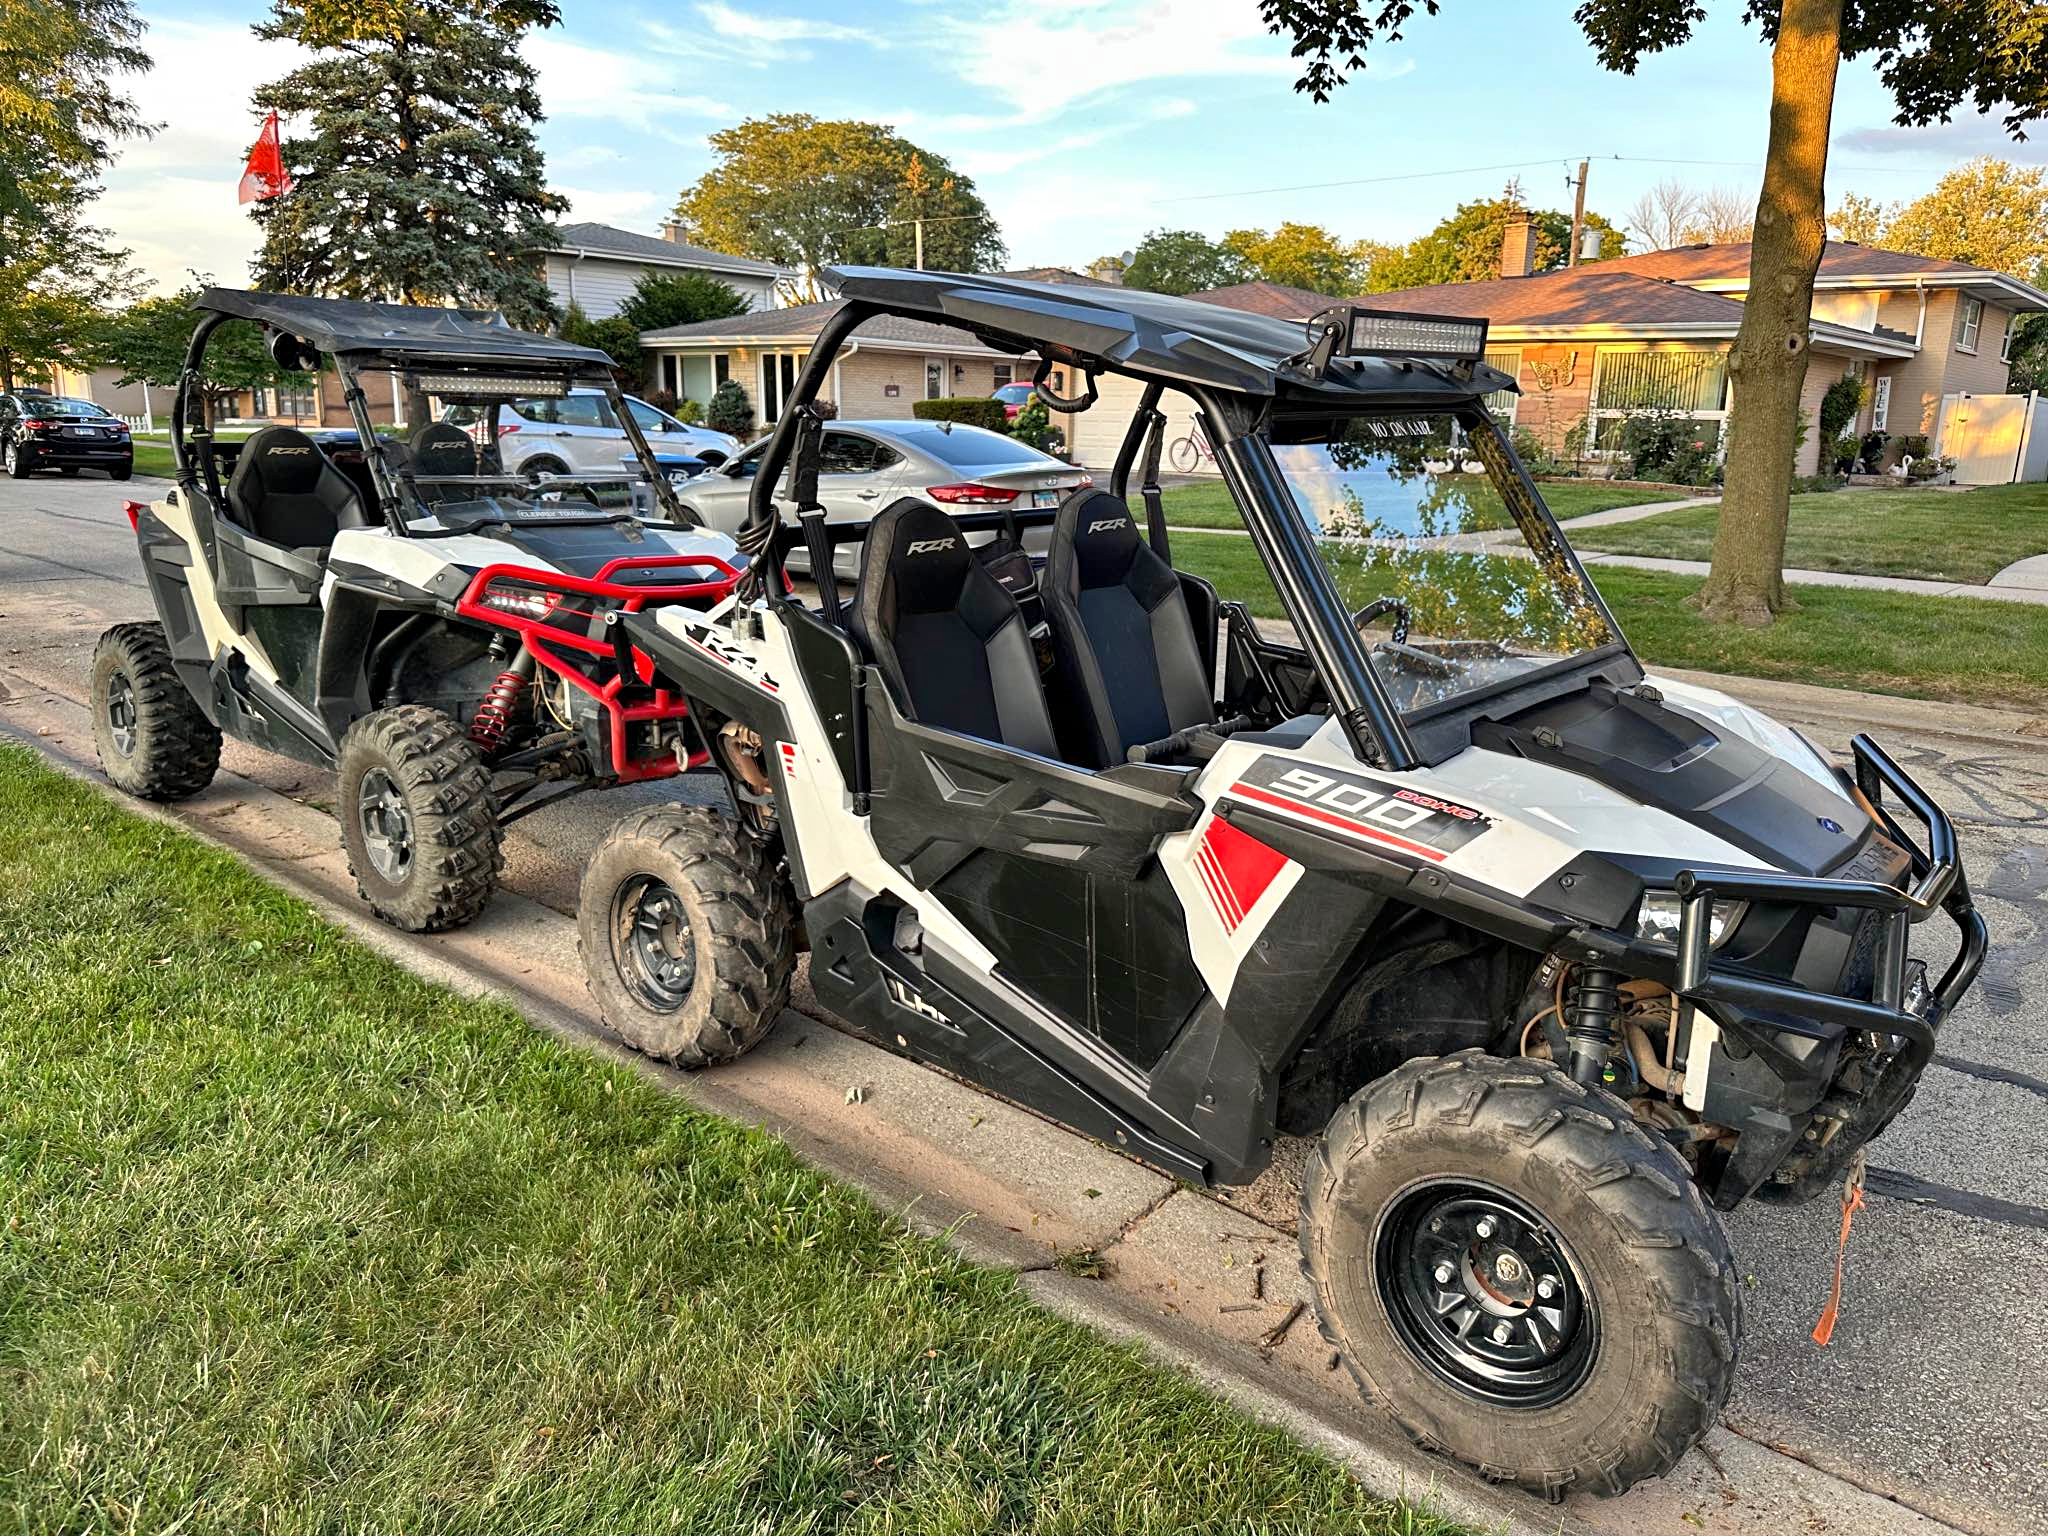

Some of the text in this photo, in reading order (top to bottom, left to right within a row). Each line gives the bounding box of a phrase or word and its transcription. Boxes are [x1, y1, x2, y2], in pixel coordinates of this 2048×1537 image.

[266, 447, 310, 456] RZR
[431, 441, 467, 449] RZR
[1087, 518, 1127, 535] RZR
[906, 537, 956, 556] RZR
[1268, 768, 1436, 829] 900
[1392, 789, 1478, 820] DOHC
